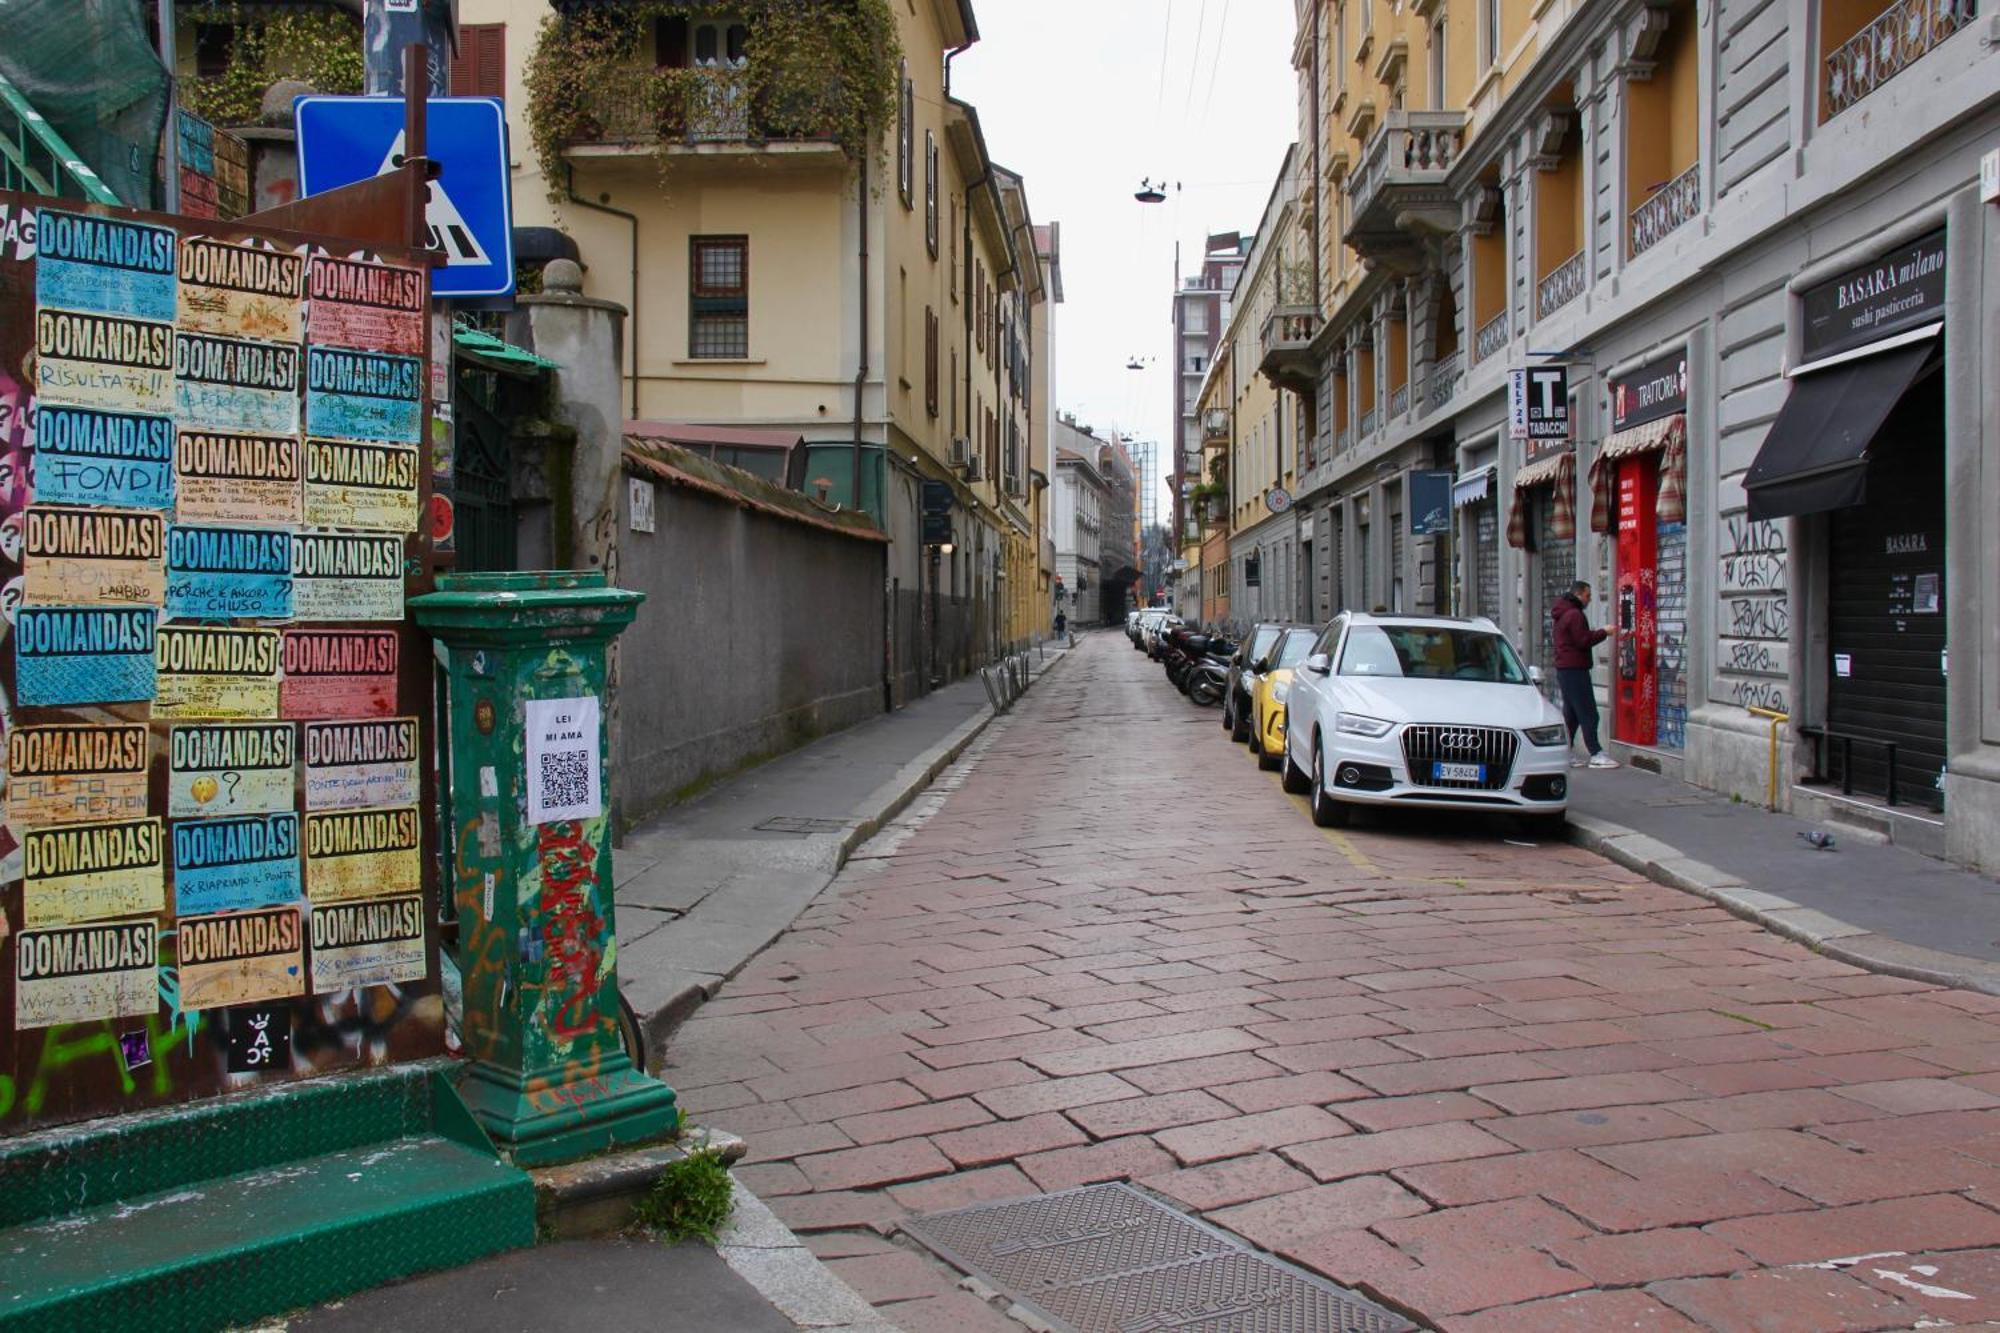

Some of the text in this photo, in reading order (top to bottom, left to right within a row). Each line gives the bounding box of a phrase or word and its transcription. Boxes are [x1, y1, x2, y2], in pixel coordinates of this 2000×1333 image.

[40, 213, 173, 271] DOMANDASI
[181, 243, 299, 295] DOMANDASI
[313, 260, 421, 309] DOMANDASI
[1838, 250, 1944, 309] BASARA milano
[1852, 288, 1924, 329] sushi pasticceria
[40, 313, 171, 367] DOMANDASI
[176, 338, 294, 388] DOMANDASI
[310, 352, 418, 398] DOMANDASI
[1638, 374, 1679, 408] TRATTORIA
[39, 410, 169, 459] DOMANDASI
[1529, 422, 1567, 435] TABACCHI
[180, 434, 297, 479] DOMANDASI
[308, 444, 415, 487] DOMANDASI
[28, 513, 159, 556] DOMANDASI
[171, 531, 290, 572] DOMANDASI
[1886, 534, 1927, 553] BASARA
[293, 537, 400, 576] DOMANDASI
[19, 613, 152, 652] DOMANDASI
[157, 632, 275, 673] DOMANDASI
[286, 636, 394, 672] DOMANDASI
[546, 731, 583, 741] MI AMA
[556, 715, 571, 723] LEI
[12, 730, 143, 773] DOMANDASI
[174, 729, 291, 768] DOMANDASI
[308, 722, 416, 765] DOMANDASI
[26, 824, 157, 876] DOMANDASI
[178, 819, 295, 866] DOMANDASI
[308, 811, 415, 856] DOMANDASI
[181, 912, 298, 961] DOMANDASI
[313, 897, 420, 947] DOMANDASI
[20, 926, 155, 977] DOMANDASI
